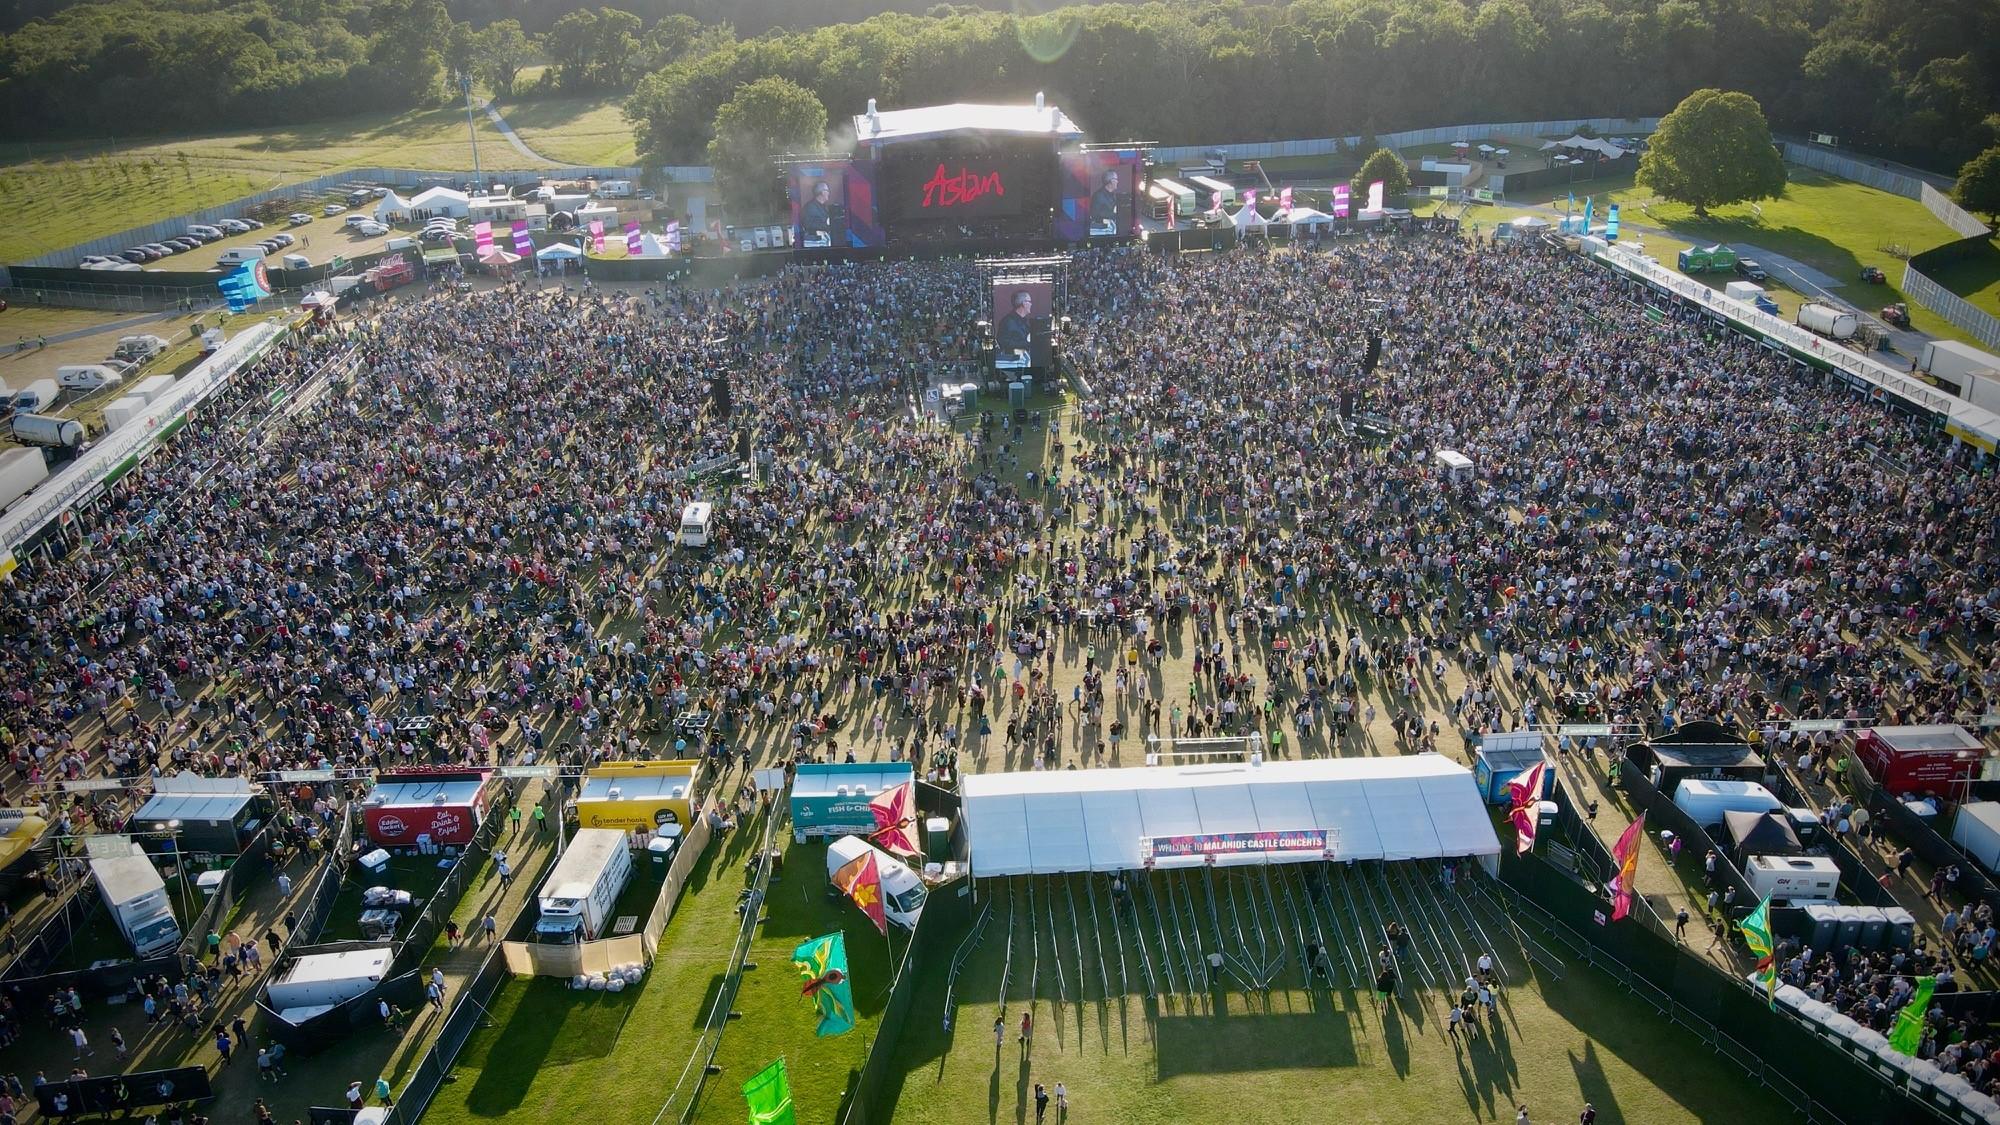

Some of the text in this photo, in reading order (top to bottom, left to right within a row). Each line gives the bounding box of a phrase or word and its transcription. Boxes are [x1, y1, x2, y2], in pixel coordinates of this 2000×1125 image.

[922, 163, 1005, 207] Aslan
[431, 819, 453, 829] Drink
[437, 823, 460, 836] Enjoy!
[1158, 838, 1322, 852] WELCOME TO MALAHIDE CASTLE CONCERTS
